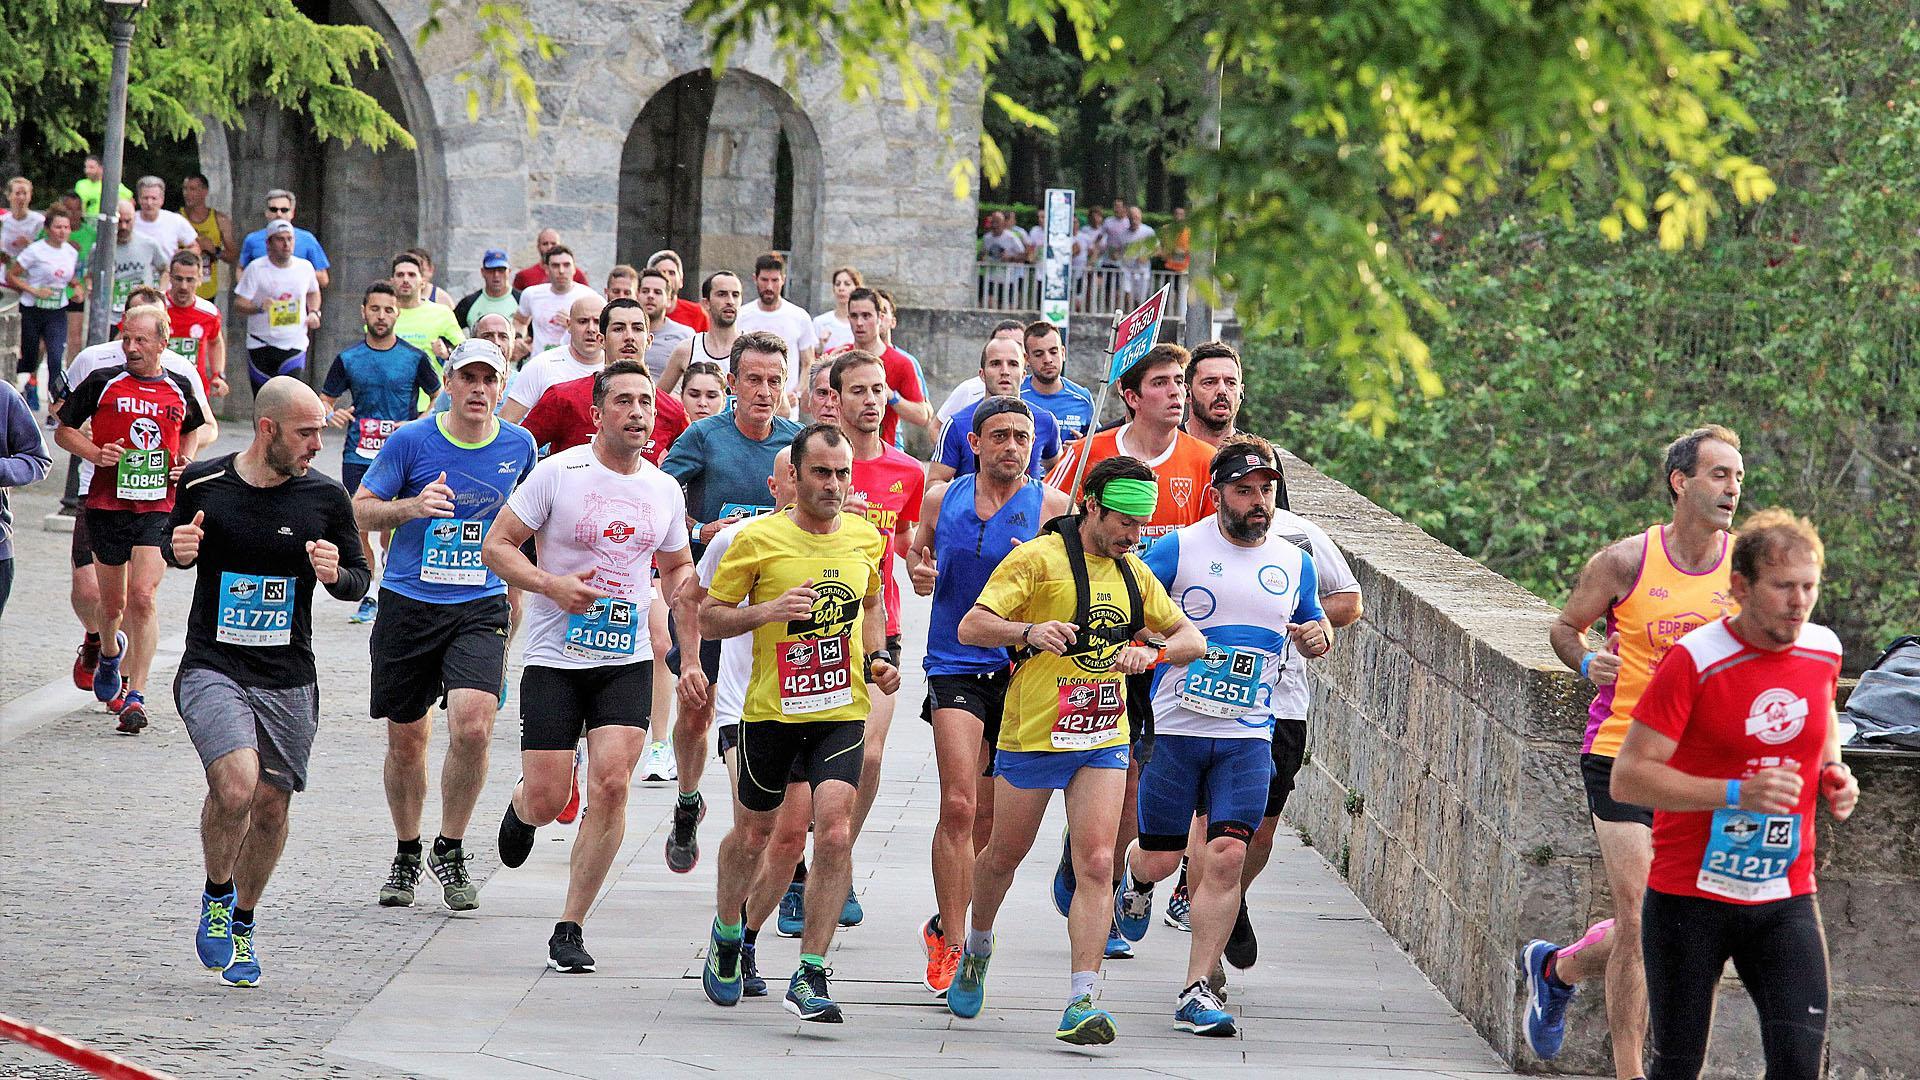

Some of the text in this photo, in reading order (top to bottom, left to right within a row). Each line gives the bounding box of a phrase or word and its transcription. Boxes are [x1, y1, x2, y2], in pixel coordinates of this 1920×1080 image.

[1127, 306, 1155, 341] 3h30
[1120, 337, 1148, 373] 1h45
[117, 397, 181, 421] RUN-15
[121, 473, 165, 488] 10845
[866, 510, 897, 529] RID
[427, 547, 484, 568] 21123
[823, 569, 839, 578] 2019
[817, 587, 848, 600] FERMIN
[1096, 592, 1112, 602] 2019
[1648, 586, 1669, 600] edp
[223, 606, 288, 628] 21776
[814, 602, 844, 624] edp
[1091, 610, 1121, 623] FERMIN
[1658, 620, 1681, 635] EDP
[570, 627, 631, 650] 21099
[784, 668, 847, 694] 42190
[1188, 673, 1251, 704] 21251
[1058, 713, 1119, 732] 42144
